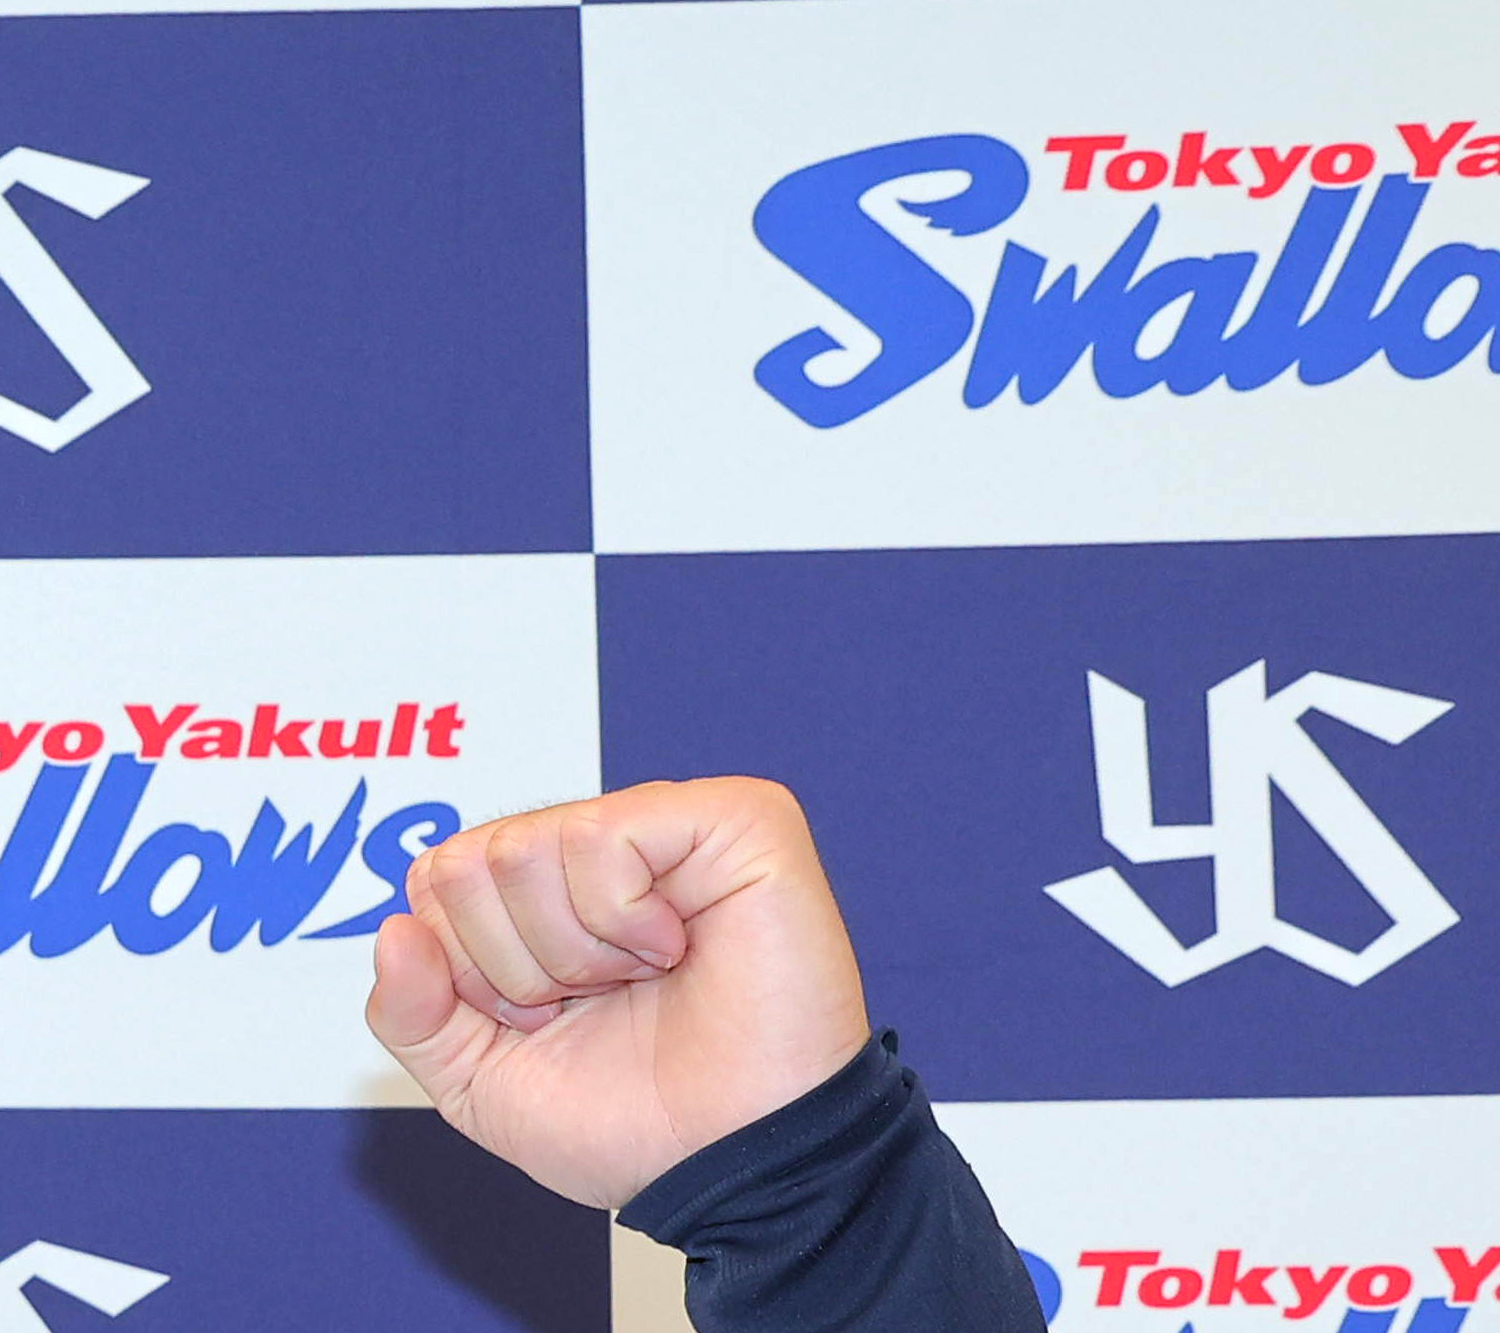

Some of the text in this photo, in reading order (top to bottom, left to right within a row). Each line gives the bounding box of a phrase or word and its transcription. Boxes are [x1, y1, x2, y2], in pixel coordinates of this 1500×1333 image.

[1045, 131, 1376, 200] Tokyo
[752, 133, 1500, 430] Swallo
[124, 702, 465, 760] Yakult
[1078, 1248, 1413, 1321] Tokyo
